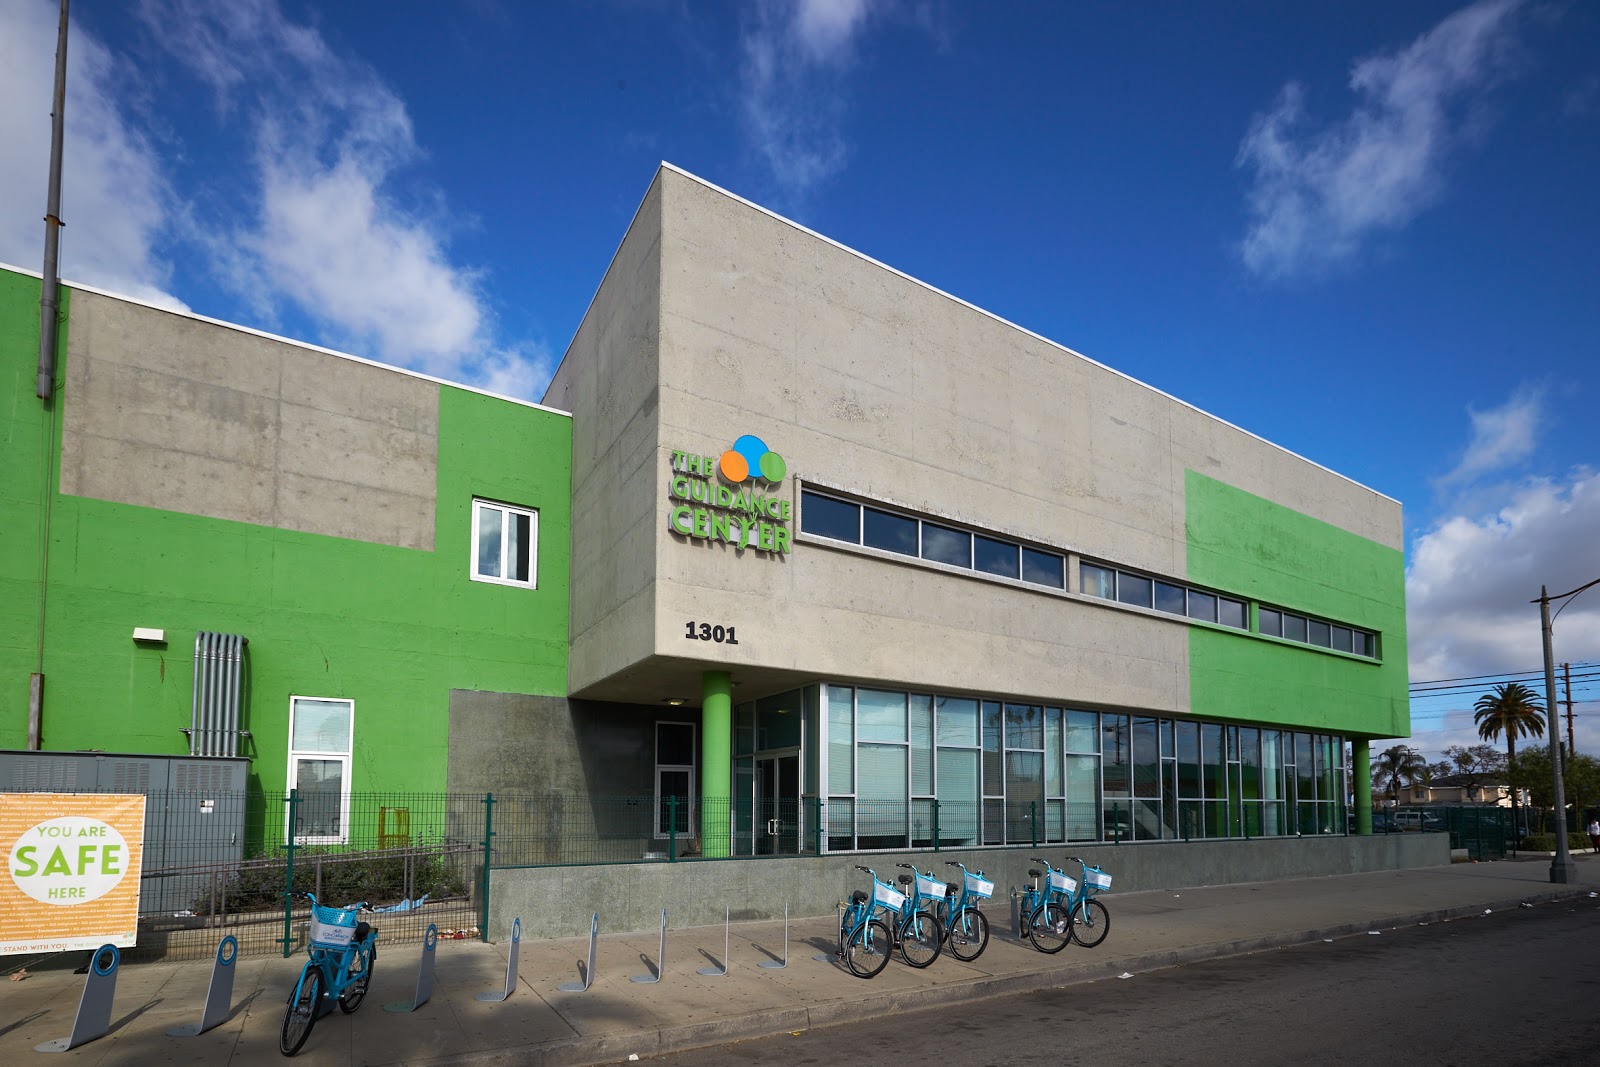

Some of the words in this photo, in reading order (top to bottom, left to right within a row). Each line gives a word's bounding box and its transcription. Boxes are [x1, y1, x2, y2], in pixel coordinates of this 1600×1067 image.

[672, 449, 714, 478] THE
[670, 476, 791, 522] GUIDANCE
[669, 505, 791, 555] CENTER
[685, 620, 739, 645] 1301
[37, 826, 72, 838] YOU
[78, 826, 107, 837] ARE
[14, 844, 121, 878] SAFE
[48, 887, 86, 899] HERE
[3, 945, 28, 953] STAND
